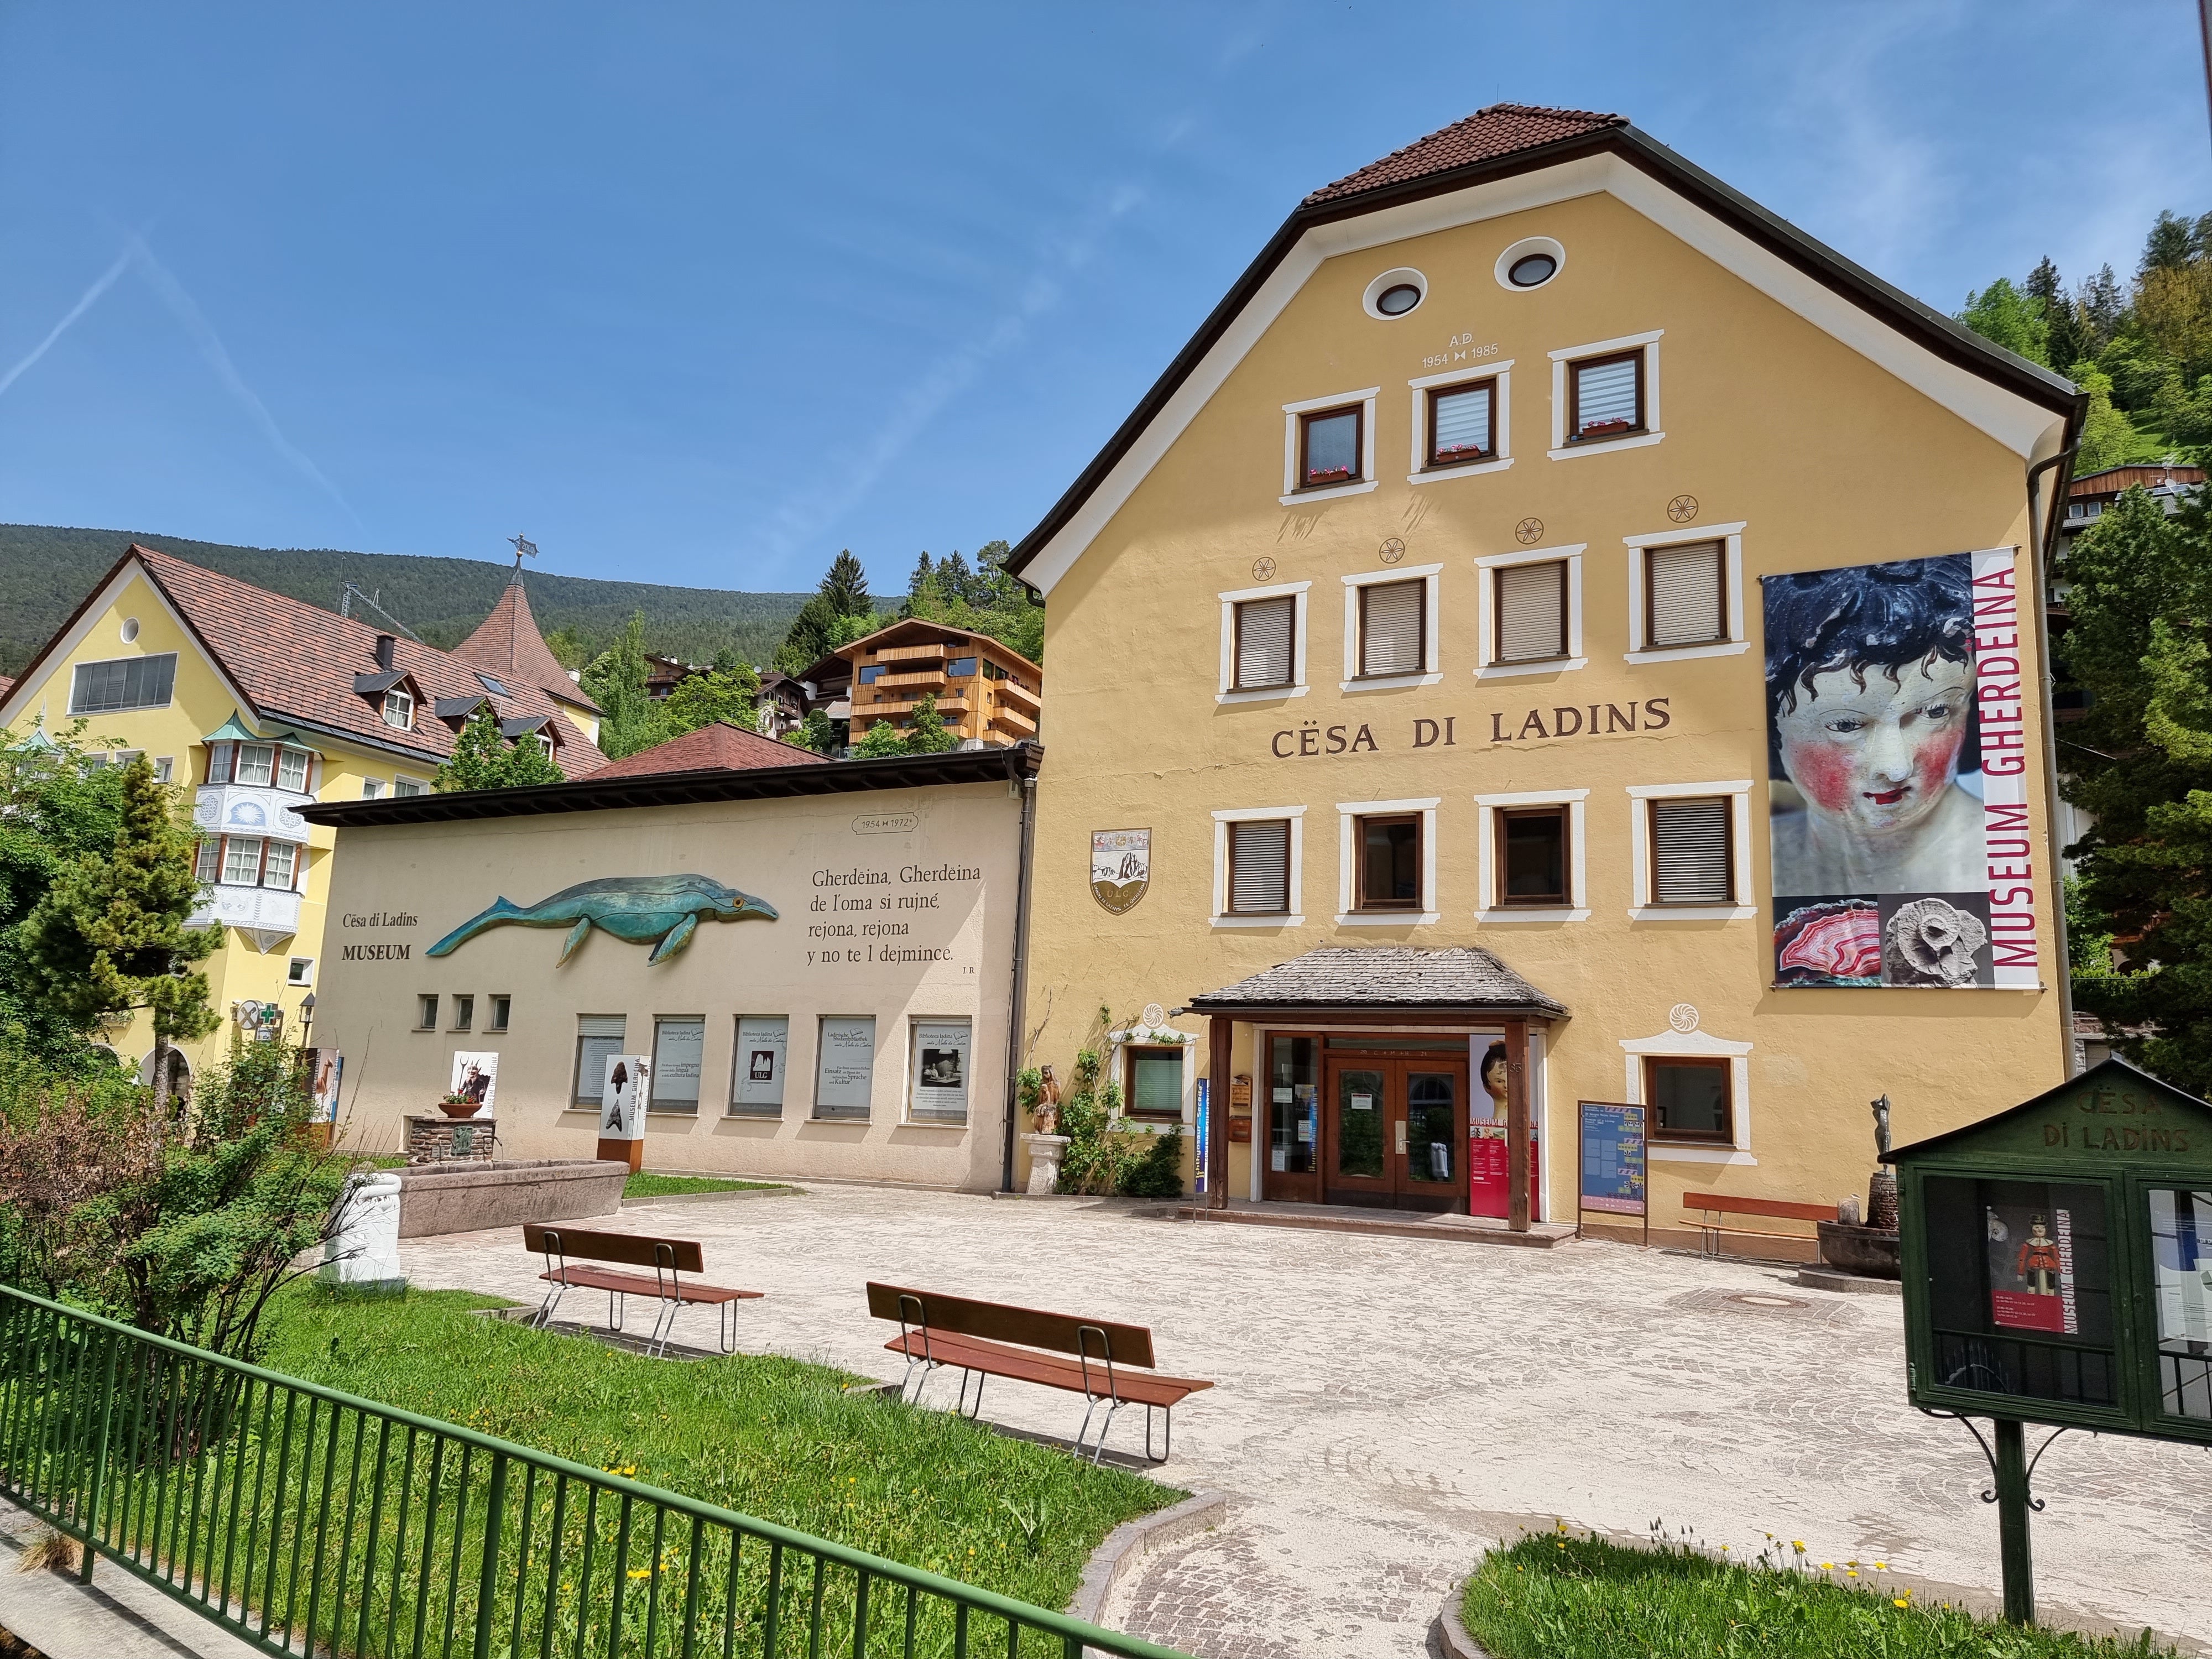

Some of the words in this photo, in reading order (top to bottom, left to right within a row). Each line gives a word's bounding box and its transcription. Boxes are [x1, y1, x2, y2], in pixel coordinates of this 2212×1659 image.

[1422, 354, 1448, 368] 1954
[1471, 343, 1498, 358] 1985
[1272, 720, 1380, 758] CËSA
[1412, 717, 1457, 748] DI
[1490, 697, 1671, 743] LADINS
[861, 819, 880, 829] 1954
[890, 818, 909, 828] 1972
[812, 868, 891, 886] Gherdëina,
[900, 864, 981, 883] Gherdëina
[1984, 804, 2038, 967] MUSEUM
[810, 895, 827, 912] de
[880, 893, 891, 910] si
[343, 912, 366, 927] Cësa
[369, 912, 380, 927] di
[383, 912, 418, 927] Ladins
[808, 921, 858, 941] rejona,
[862, 920, 910, 940] rejona
[342, 945, 411, 961] MUSEUM
[807, 950, 816, 966] y
[821, 950, 840, 963] no
[847, 948, 861, 962] te
[879, 945, 953, 966] dejmincë.
[1471, 1118, 1499, 1126] MUSEUM
[2062, 1282, 2078, 1334] MUSEUM
